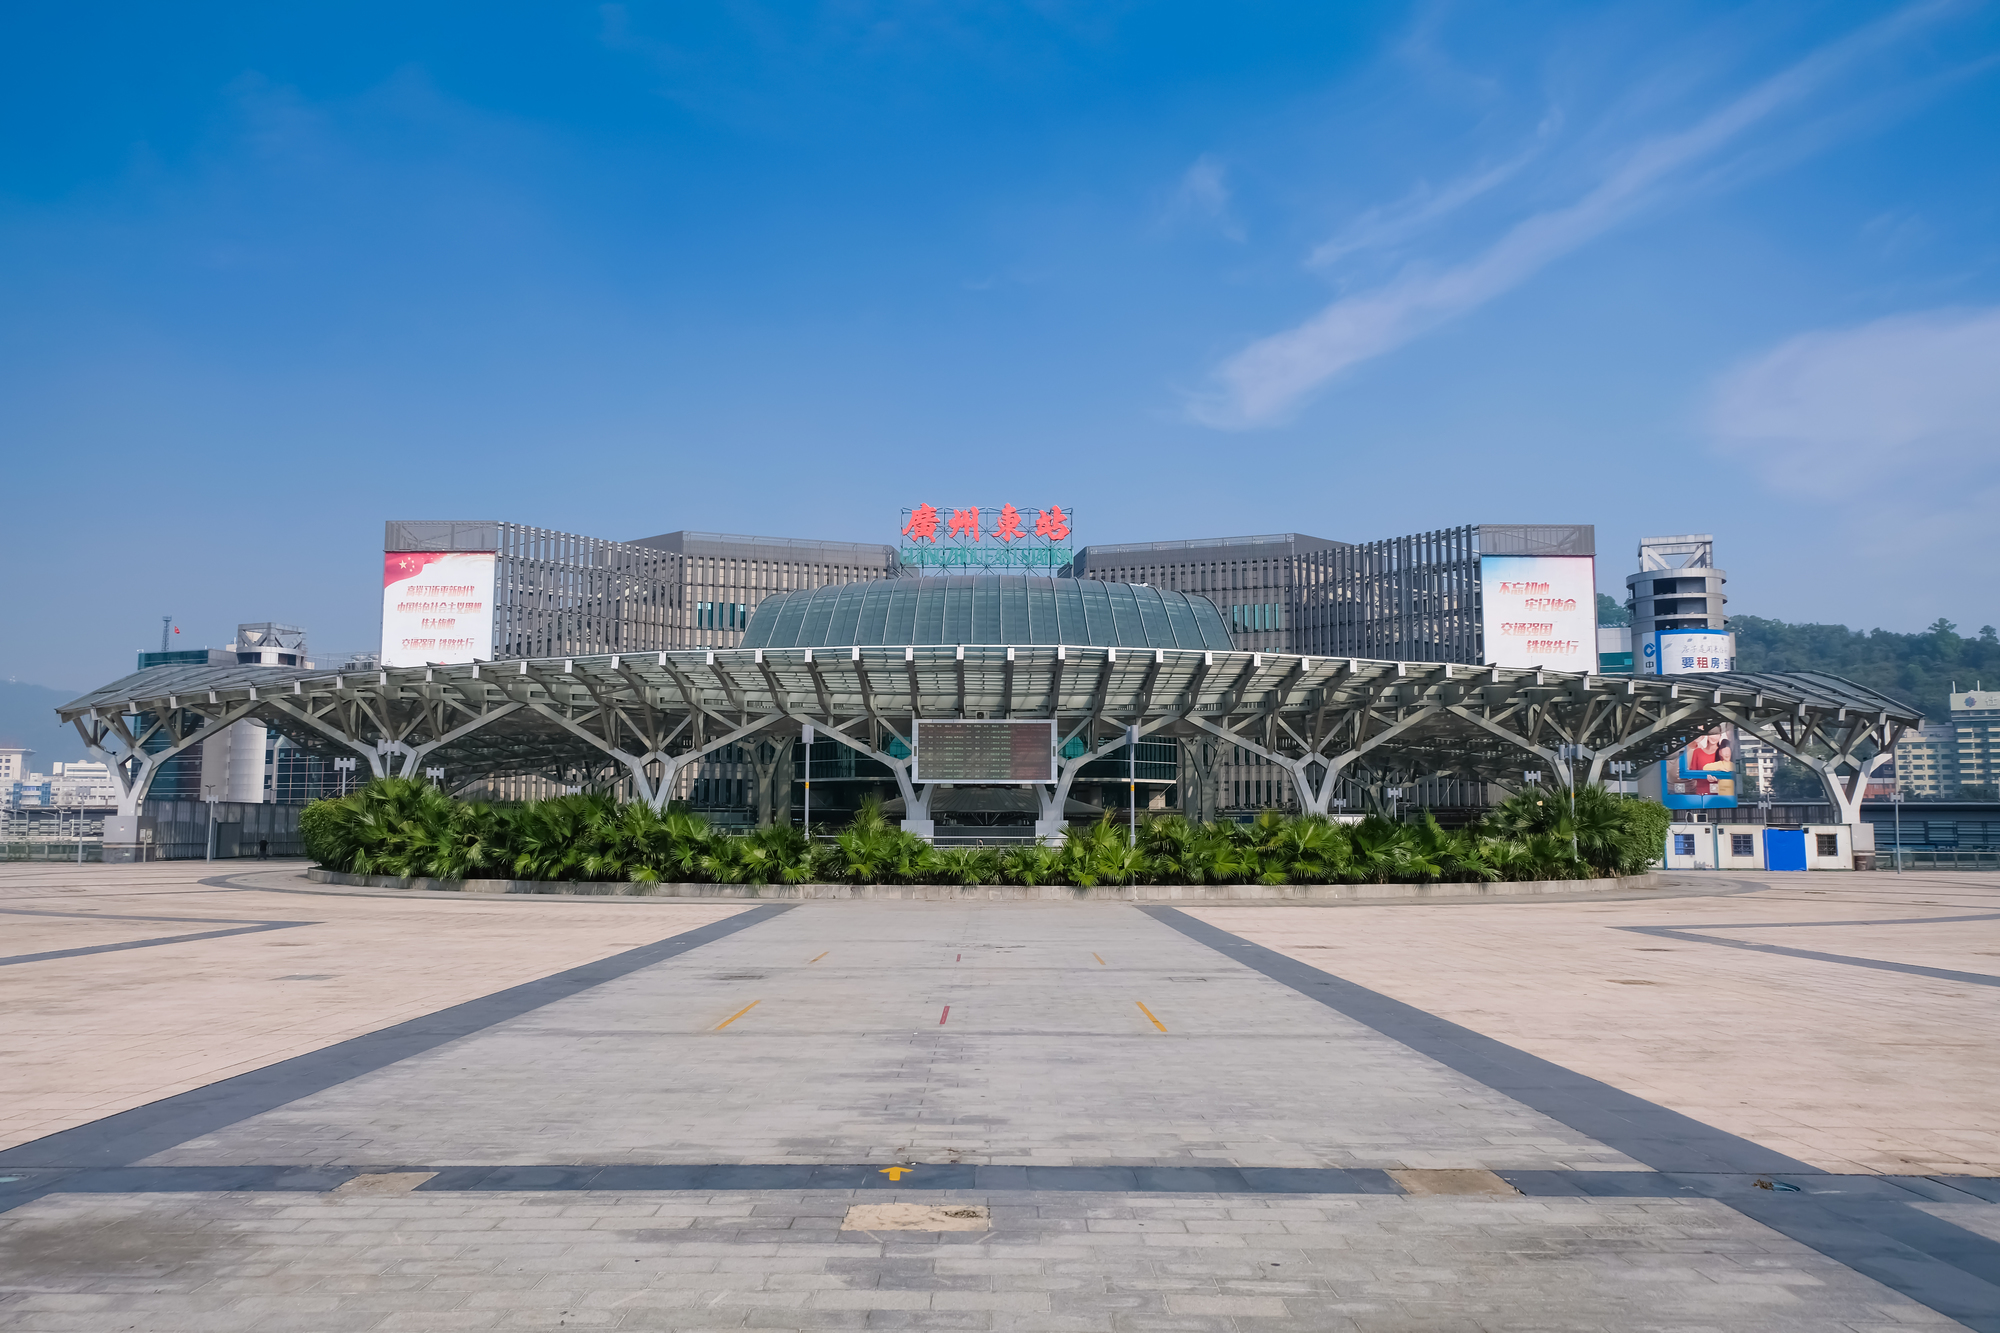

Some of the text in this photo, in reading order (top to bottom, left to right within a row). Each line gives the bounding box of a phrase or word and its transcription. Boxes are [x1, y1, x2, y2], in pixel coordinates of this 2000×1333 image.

[902, 502, 1071, 543] 廣州東站
[899, 547, 1074, 565] GUANGZHOU EAST STATION
[1498, 582, 1550, 595] 不忘初心
[397, 602, 482, 614] 中国特色社会主义思想
[1524, 598, 1577, 612] 牢记使命
[1500, 622, 1553, 637] 交通强国
[1526, 640, 1579, 655] 铁路先行
